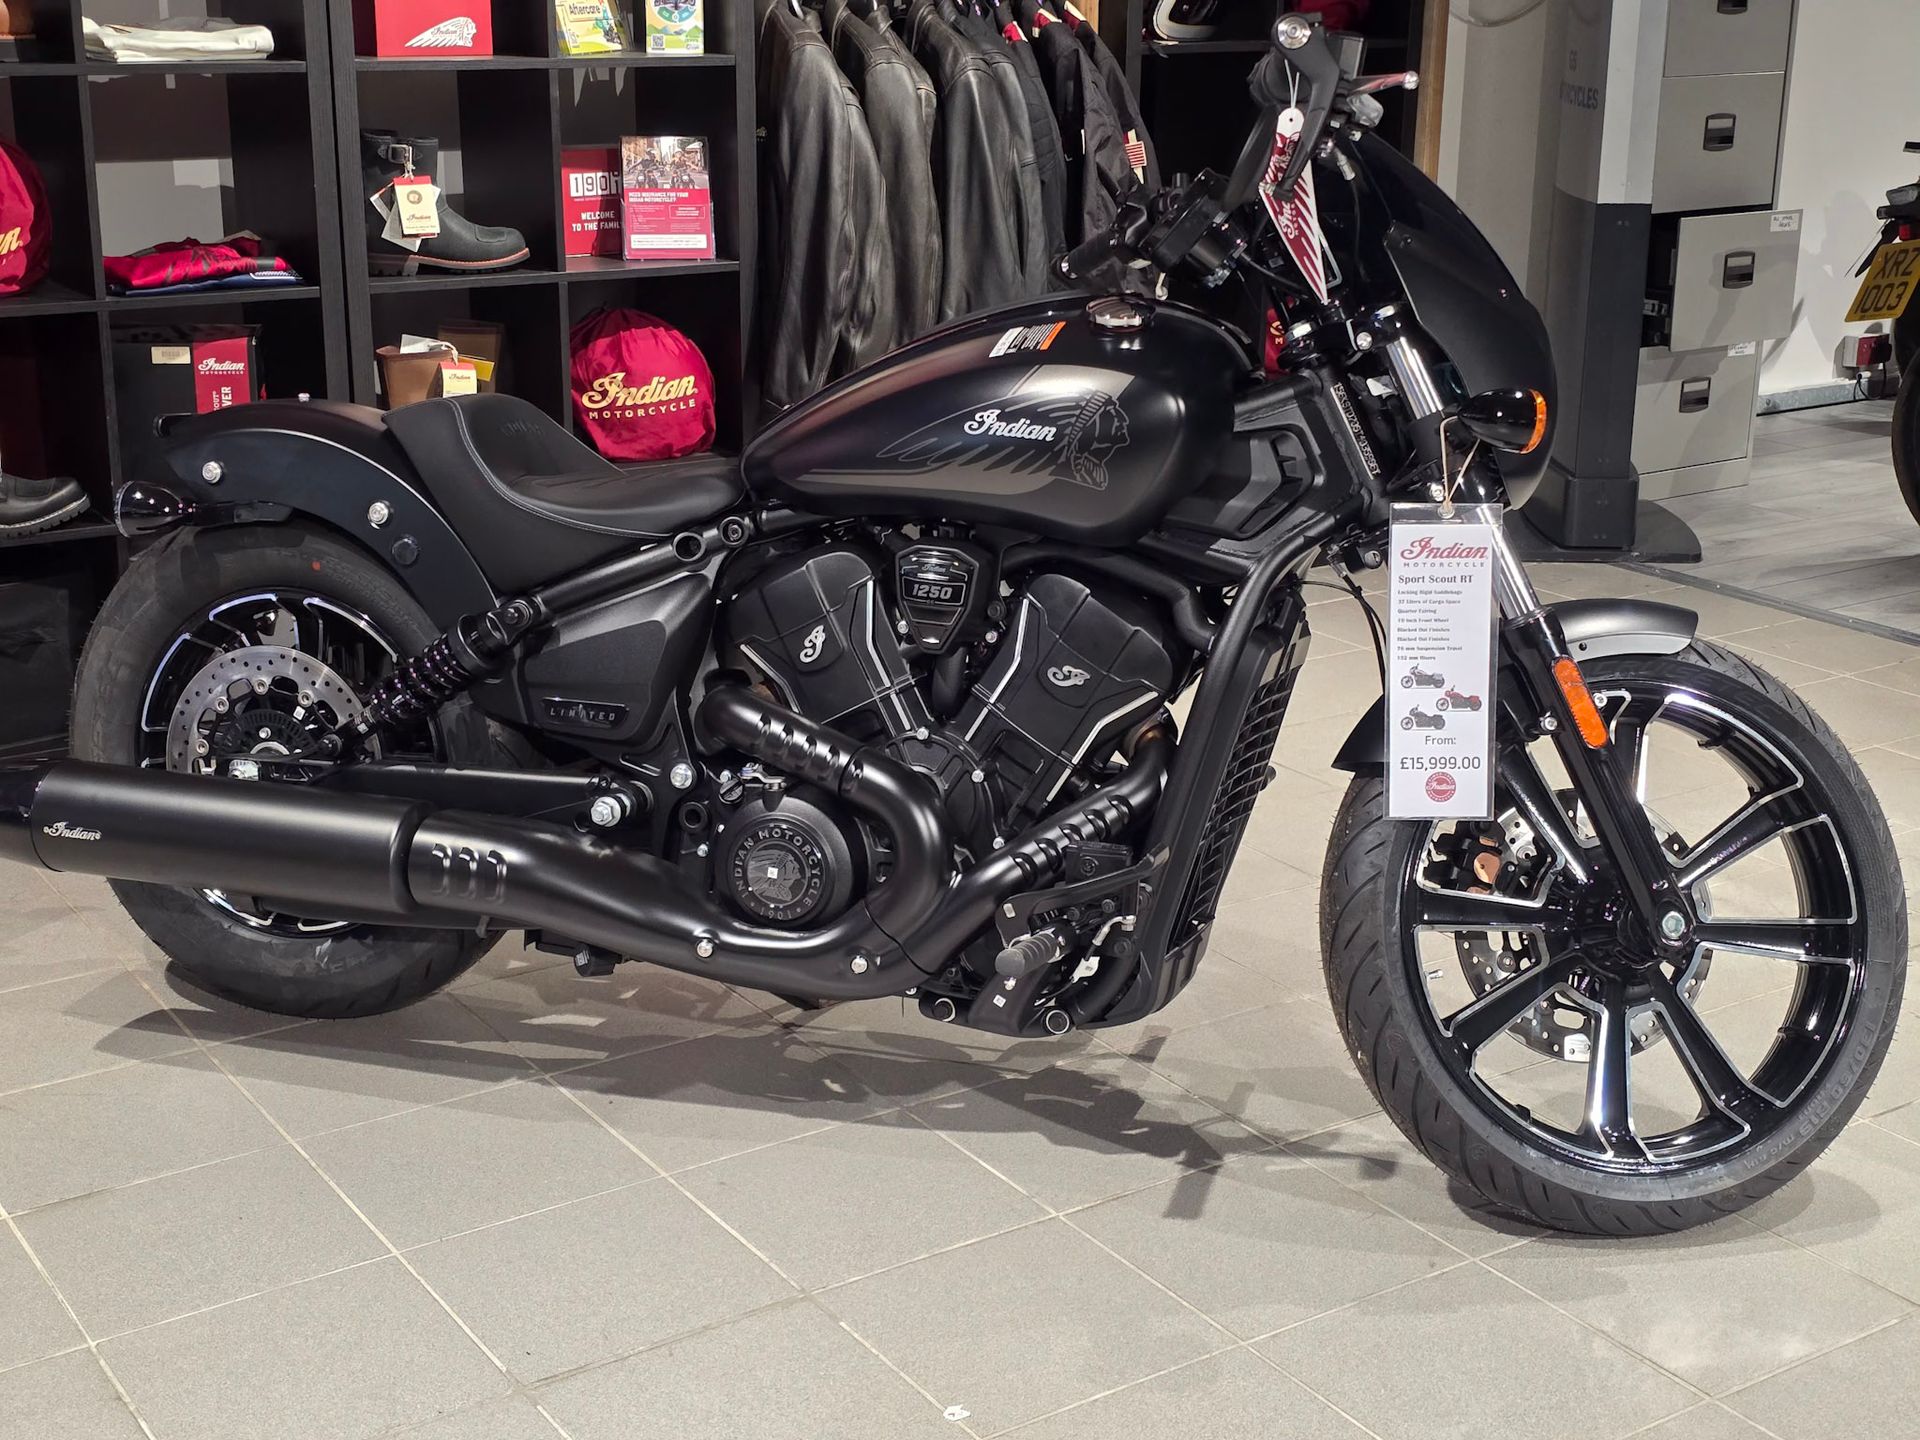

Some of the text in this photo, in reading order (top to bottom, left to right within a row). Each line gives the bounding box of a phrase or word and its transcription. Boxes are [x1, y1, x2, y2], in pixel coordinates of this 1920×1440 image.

[569, 4, 601, 14] Aftercare
[581, 211, 615, 220] WELCOME
[572, 223, 581, 232] TO
[584, 222, 598, 231] THE
[600, 221, 621, 229] FAMIL
[198, 358, 245, 370] Indian
[582, 372, 697, 409] Indian
[589, 399, 696, 419] MOTORCYCLE
[964, 410, 1057, 442] Indian
[1400, 536, 1489, 560] Indian
[1398, 575, 1474, 585] Sport Scout RT
[912, 583, 953, 599] 1250
[550, 707, 615, 721] LIMITED
[1425, 735, 1457, 745] From:
[1400, 756, 1481, 771] £15,999.00
[47, 821, 97, 841] Indian
[733, 828, 822, 907] INDIAN MOTORCYCLE
